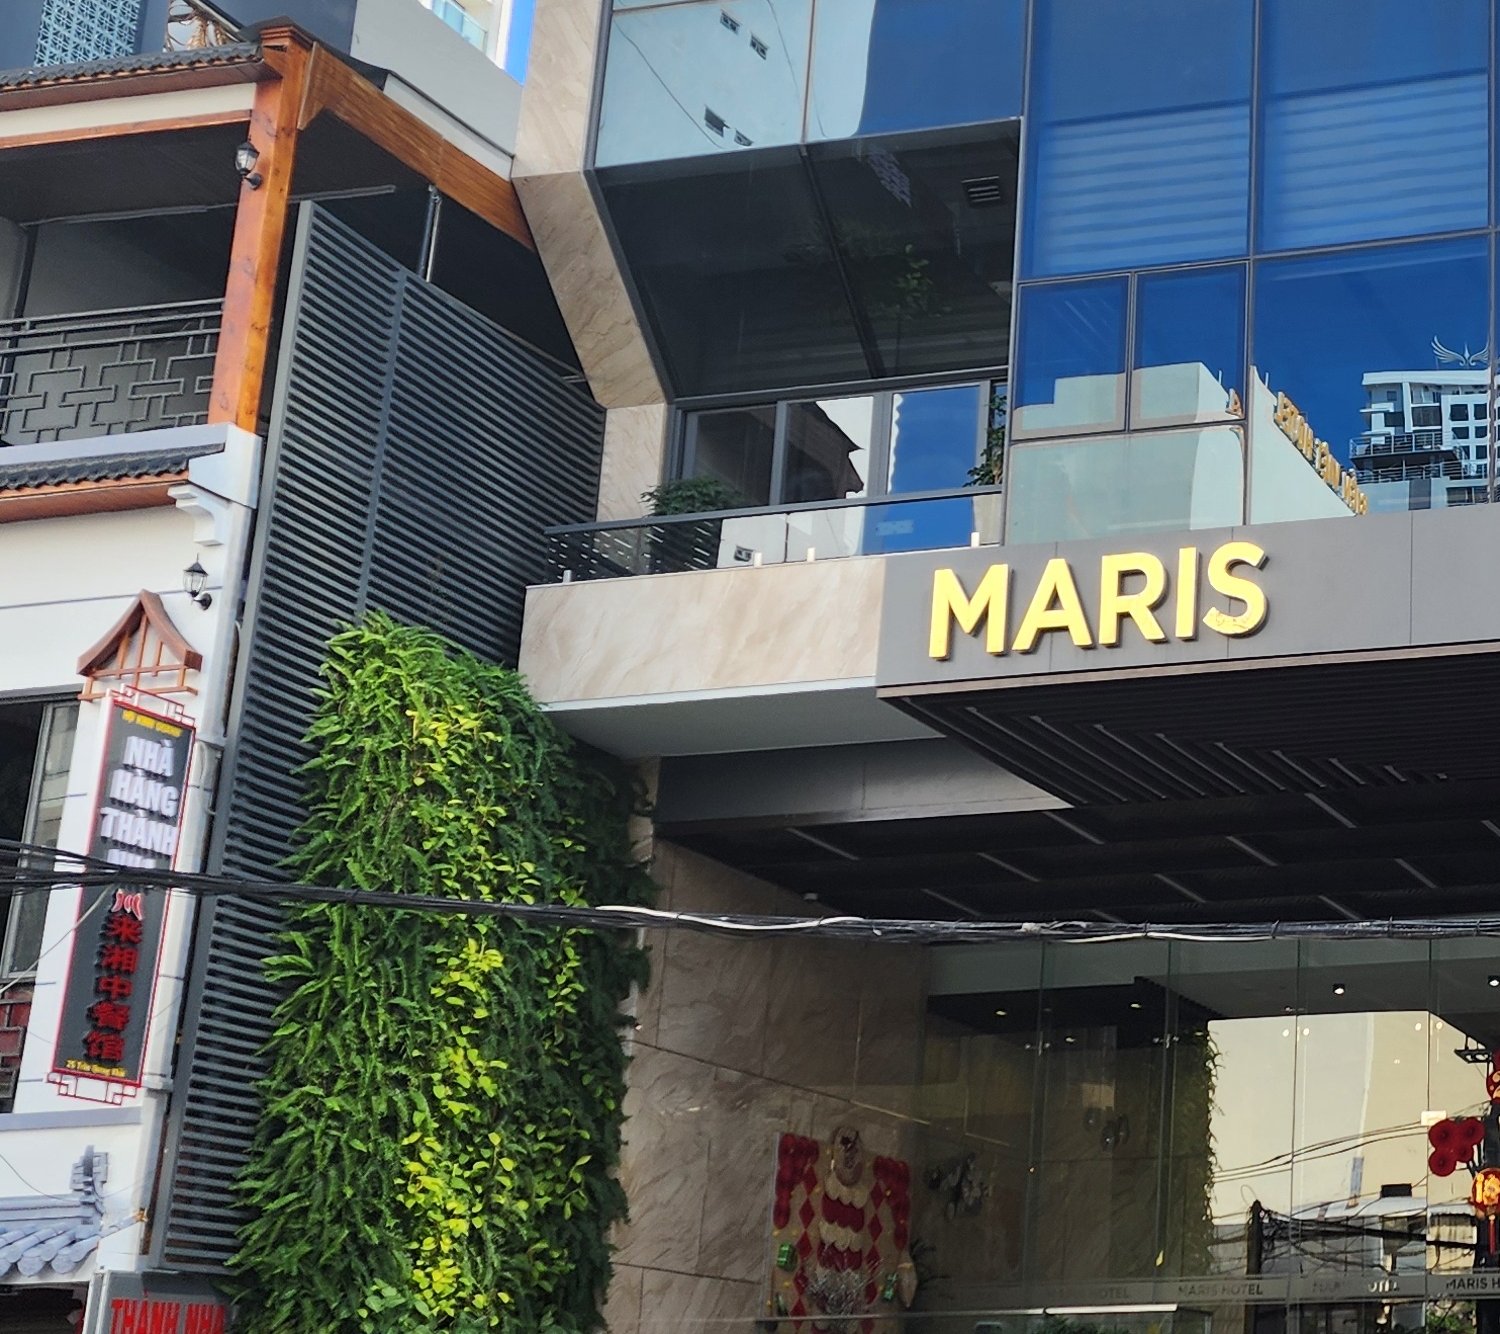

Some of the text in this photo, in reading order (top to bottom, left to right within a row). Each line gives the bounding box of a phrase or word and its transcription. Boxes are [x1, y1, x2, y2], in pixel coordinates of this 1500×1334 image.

[929, 541, 1268, 660] MARIS
[123, 735, 175, 777] NHÀ
[109, 768, 180, 818] HÀNG
[100, 807, 178, 856] THÀNH
[1446, 1278, 1487, 1291] MARIS
